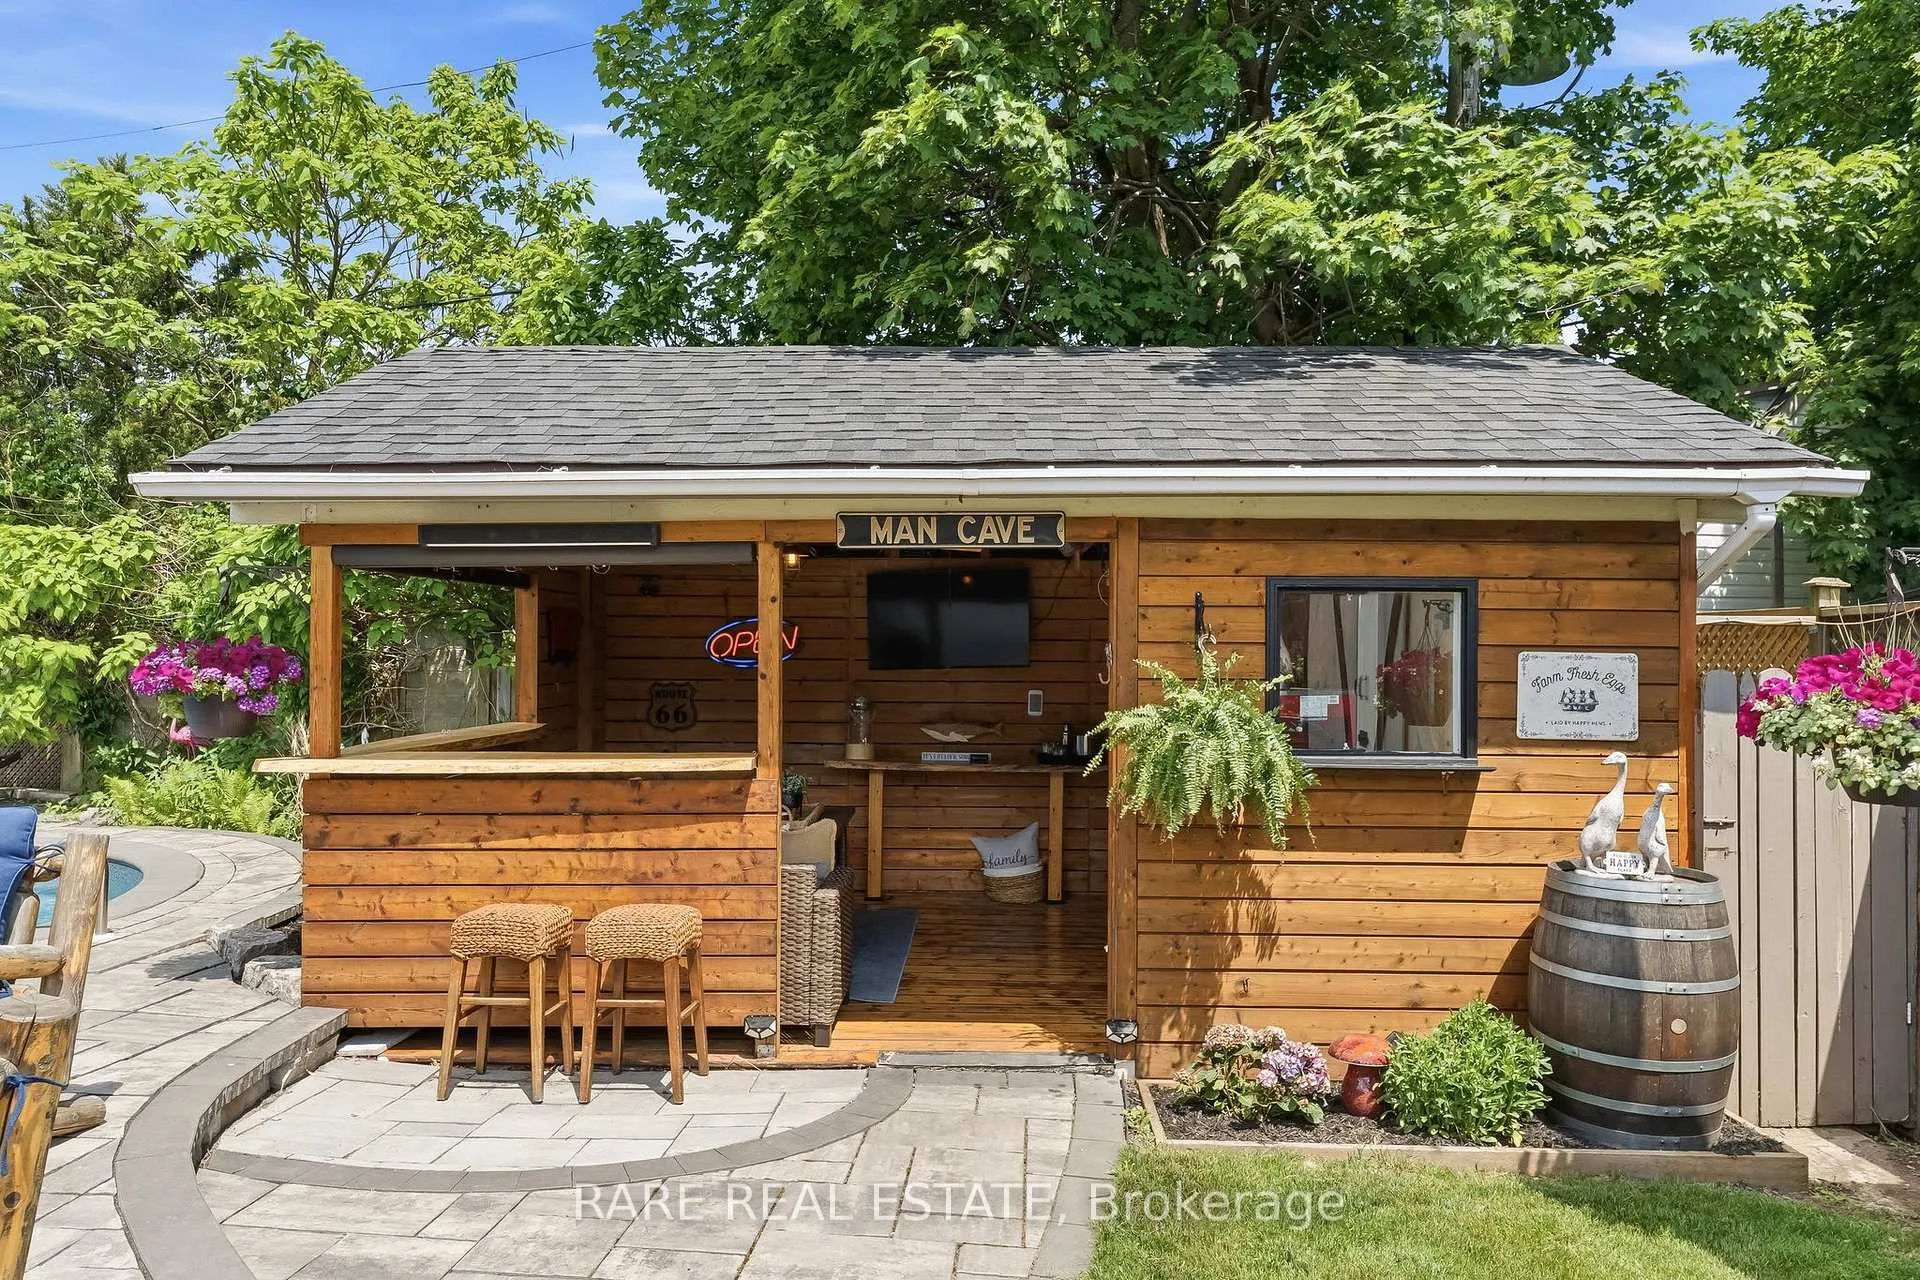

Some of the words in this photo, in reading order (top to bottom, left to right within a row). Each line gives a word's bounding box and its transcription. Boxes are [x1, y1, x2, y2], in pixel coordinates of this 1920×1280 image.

[870, 516, 937, 545] MAN
[957, 515, 1035, 545] CAVE
[1531, 672, 1564, 693] Farm
[1566, 666, 1600, 681] Fresh
[1601, 672, 1626, 694] Eggs
[655, 690, 688, 699] ROUTE
[655, 704, 688, 724] 66
[985, 848, 1035, 869] family
[1610, 858, 1640, 868] HAPPY
